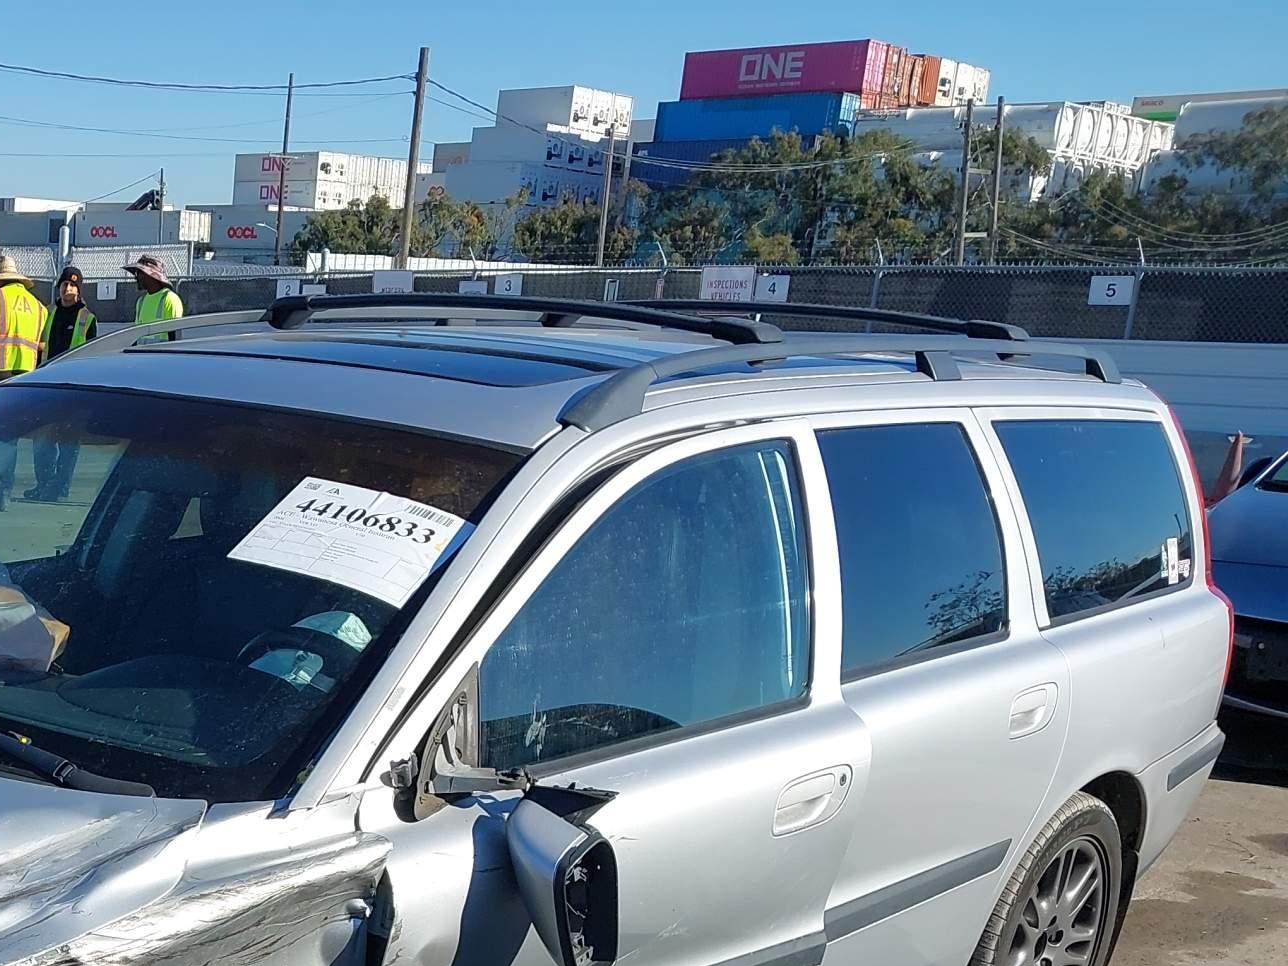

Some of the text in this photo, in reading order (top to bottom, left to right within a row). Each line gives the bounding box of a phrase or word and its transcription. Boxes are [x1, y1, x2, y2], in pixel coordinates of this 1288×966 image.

[739, 51, 806, 81] ONE
[90, 226, 118, 238] OOCL
[227, 226, 258, 239] OOCL
[284, 285, 292, 296] 2
[504, 279, 512, 291] 3
[767, 281, 777, 295] 4
[1105, 283, 1117, 297] 5
[295, 499, 436, 544] 44106833
